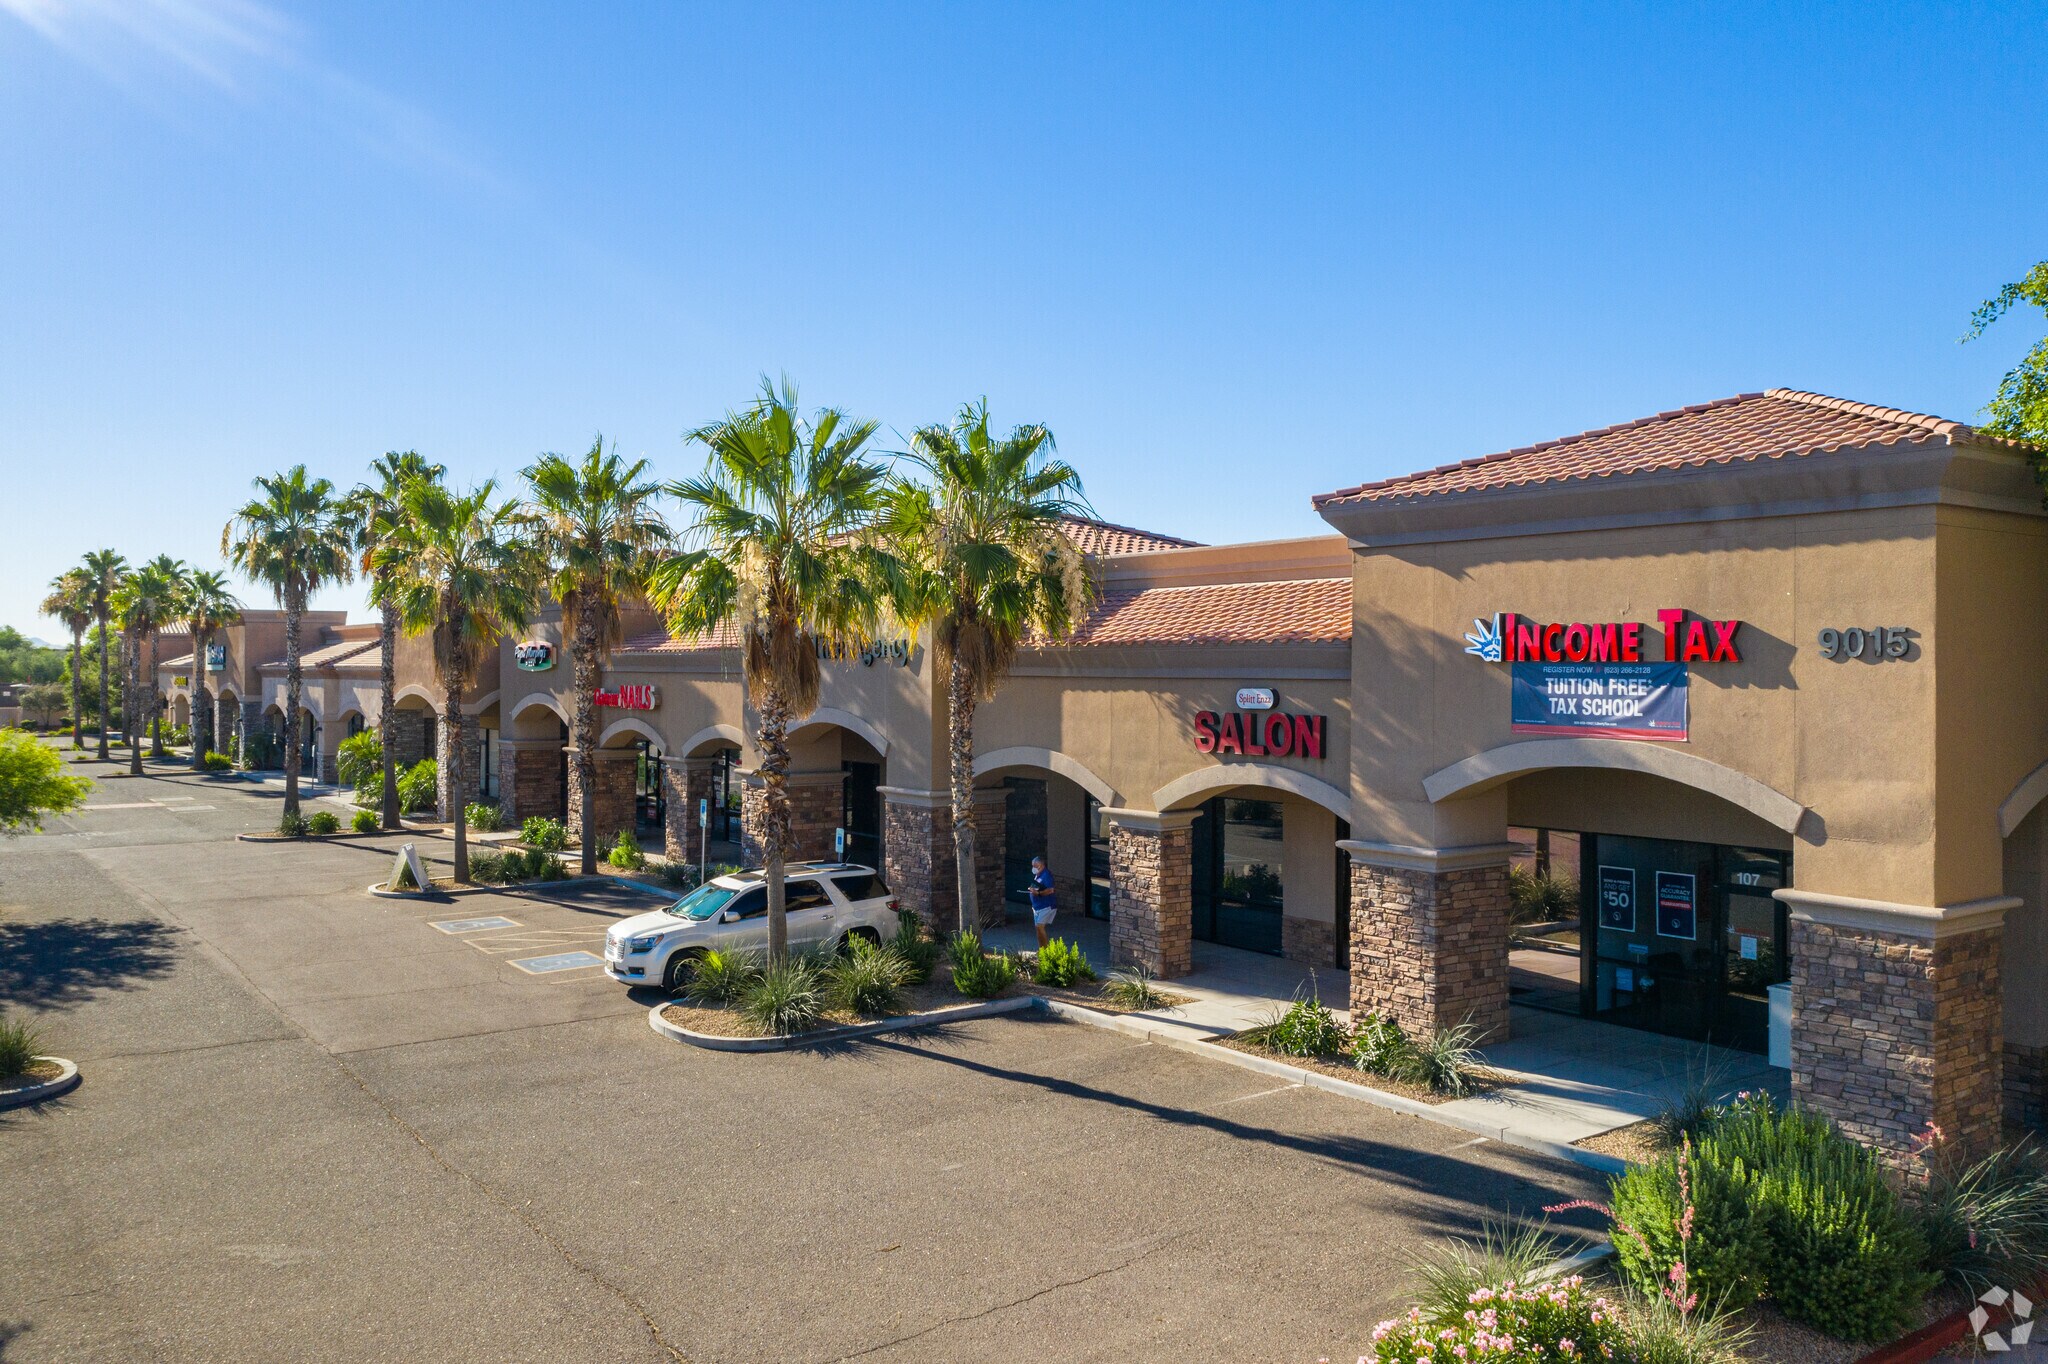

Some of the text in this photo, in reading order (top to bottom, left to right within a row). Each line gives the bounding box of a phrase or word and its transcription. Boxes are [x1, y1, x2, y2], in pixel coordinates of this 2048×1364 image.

[1505, 608, 1740, 662] INCOME TAX
[1817, 626, 1910, 658] 9015
[1604, 666, 1620, 674] (623)
[1620, 666, 1651, 674] 266-2128
[1545, 678, 1603, 695] TUITION
[618, 685, 653, 710] NAILS
[1549, 697, 1643, 717] TAX SCHOOL
[1194, 710, 1323, 759] SALON
[1618, 884, 1631, 892] GET
[1736, 872, 1761, 886] 107
[1603, 890, 1630, 908] $50
[1660, 887, 1691, 896] ACCURACY
